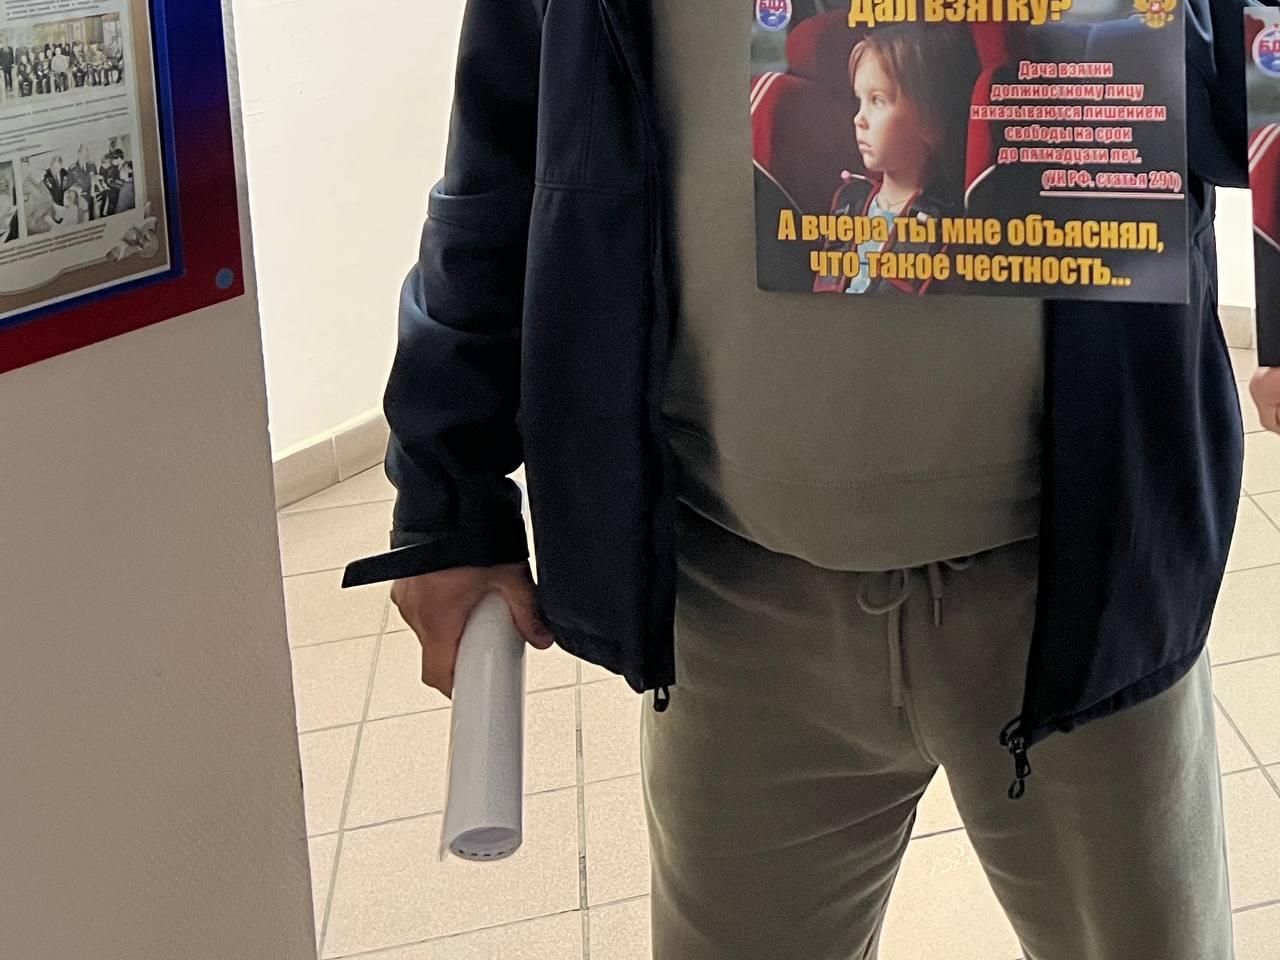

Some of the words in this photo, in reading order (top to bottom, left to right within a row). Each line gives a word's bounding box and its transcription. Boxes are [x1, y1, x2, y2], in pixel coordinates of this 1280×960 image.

[1018, 60, 1057, 80] Дача
[1058, 62, 1114, 78] взятки
[990, 84, 1104, 101] должностному
[1104, 84, 1144, 101] лицу
[970, 105, 1082, 120] наказываются
[1082, 105, 1167, 121] лишением
[1004, 124, 1073, 143] свободы
[1074, 126, 1094, 141] на
[1095, 126, 1132, 144] срок
[997, 147, 1018, 164] до
[1019, 147, 1109, 164] пятнадцати
[1109, 148, 1142, 164] лет.
[1096, 171, 1148, 189] статья
[1149, 171, 1182, 193] 291)
[777, 209, 797, 240] А
[801, 214, 889, 245] вчера
[893, 216, 937, 243] ты
[941, 217, 1001, 245] мне
[1007, 213, 1165, 253] объяснял,
[810, 250, 860, 277] что
[864, 250, 950, 280] такое
[955, 253, 1132, 287] честность...
